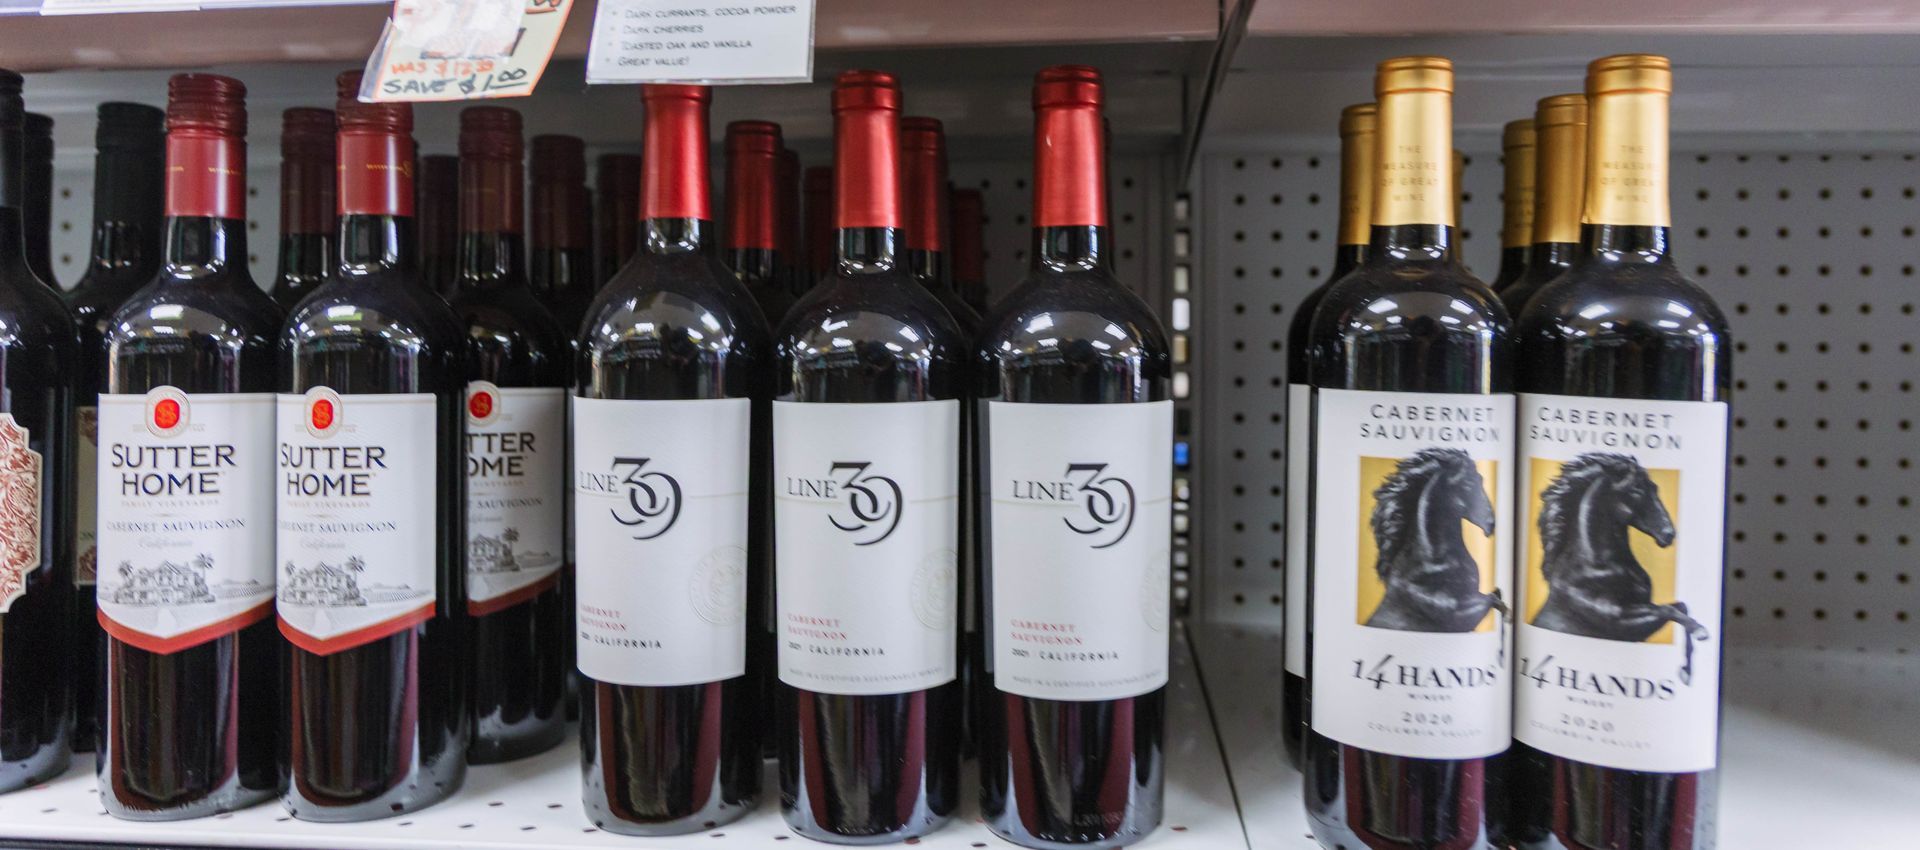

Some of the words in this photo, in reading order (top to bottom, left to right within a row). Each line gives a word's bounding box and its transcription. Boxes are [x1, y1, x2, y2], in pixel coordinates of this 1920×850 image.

[714, 7, 750, 17] COCOA
[753, 5, 797, 15] POWDER
[653, 25, 703, 34] CHERRIES
[622, 40, 663, 51] TOASTED
[666, 40, 685, 50] OAK
[690, 40, 710, 49] AND
[713, 40, 752, 48] VANILLA
[618, 56, 650, 66] GREAT
[383, 78, 456, 94] SAVE
[1398, 145, 1423, 155] THE
[1620, 144, 1646, 154] THE
[1381, 161, 1439, 172] MEASURE
[1380, 177, 1395, 187] OF
[1600, 176, 1616, 187] OF
[1393, 193, 1426, 202] WINE
[1370, 403, 1495, 422] CABERNET
[1537, 406, 1673, 429] CABERNET
[1360, 423, 1500, 442] SAUVIGNON
[1529, 424, 1682, 450] SAUVIGNON
[465, 432, 537, 454] TTER
[112, 443, 237, 468] SUTTER
[280, 442, 389, 470] SUTTER
[468, 456, 525, 477] OME
[121, 472, 220, 496] HOME
[287, 472, 372, 496] HOME
[158, 499, 220, 507] VINEYARDS
[478, 497, 544, 509] SAUVIGNON
[580, 471, 619, 494] LINE
[610, 456, 682, 540] 39
[787, 477, 838, 499] LINE
[828, 461, 903, 546] 39
[1012, 480, 1075, 501] LINE
[1063, 463, 1136, 548] 39
[163, 518, 247, 533] SAUVIGNON
[319, 519, 399, 534] SAUVIGNON
[787, 613, 841, 628] CABERNET
[1010, 618, 1075, 633] CABERNET
[787, 625, 848, 641] SAUVIGNON
[1010, 632, 1083, 646] SAUVIGNON
[594, 635, 662, 649] CALIFORNIA
[809, 645, 885, 657] CALIFORNIA
[1039, 650, 1119, 663] CALIFORNIA
[1352, 653, 1395, 690] 14
[1397, 664, 1497, 689] HANDS
[1519, 654, 1555, 689] 14
[1557, 666, 1676, 701] HANDS
[1408, 693, 1452, 701] WINERY
[1566, 695, 1614, 709] WINERY
[1402, 711, 1454, 725] 2020
[1561, 713, 1615, 732] 2020
